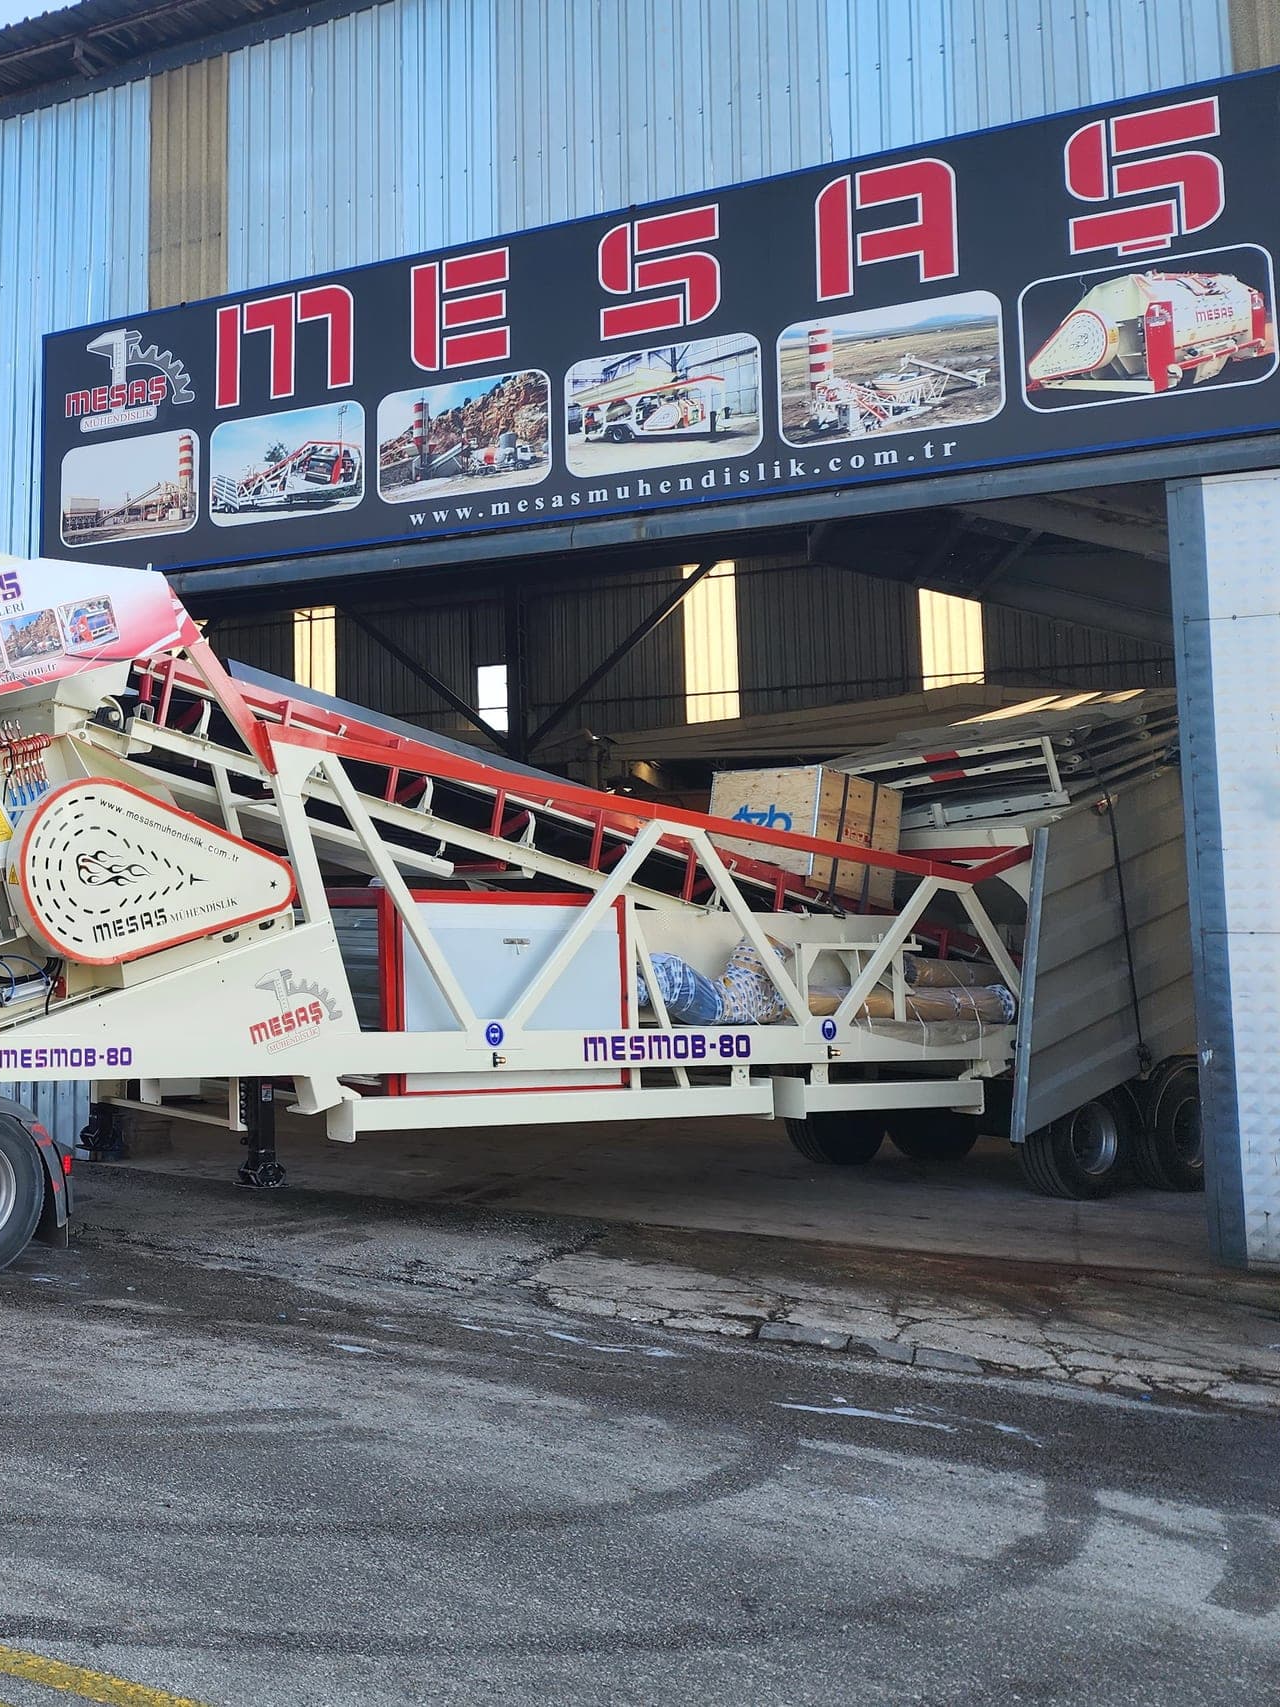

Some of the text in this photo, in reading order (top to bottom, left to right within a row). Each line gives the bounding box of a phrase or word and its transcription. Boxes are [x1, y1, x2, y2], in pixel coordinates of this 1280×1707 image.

[409, 439, 957, 527] www.mesasmuhendislik.com.tr
[0, 1047, 132, 1069] MESMOB-80
[583, 1034, 751, 1062] MESMOB-80
